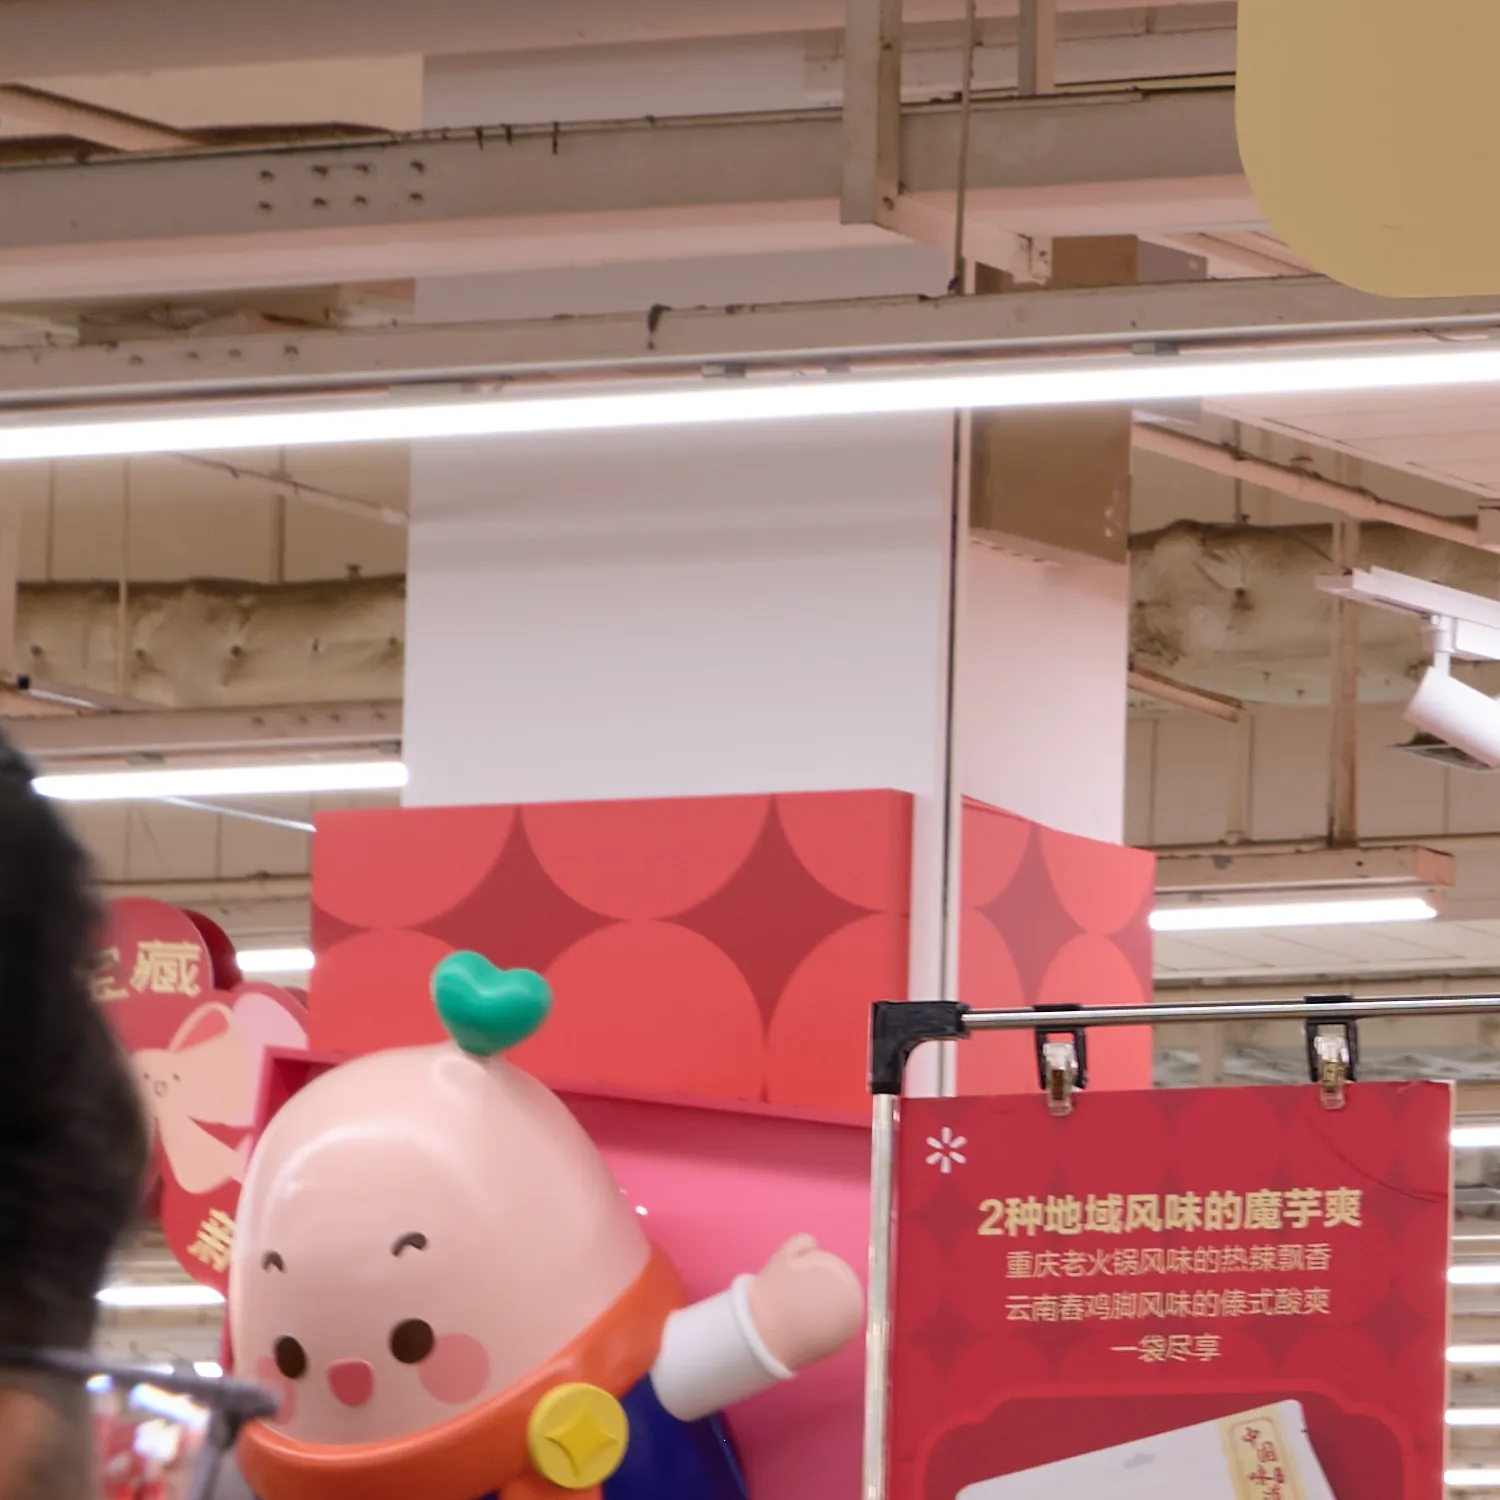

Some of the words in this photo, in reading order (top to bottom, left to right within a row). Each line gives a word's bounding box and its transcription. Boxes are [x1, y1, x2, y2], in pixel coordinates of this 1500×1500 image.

[976, 1186, 1364, 1238] 2种地域风味的魔芋爽
[1109, 1332, 1223, 1363] 一袋尽享
